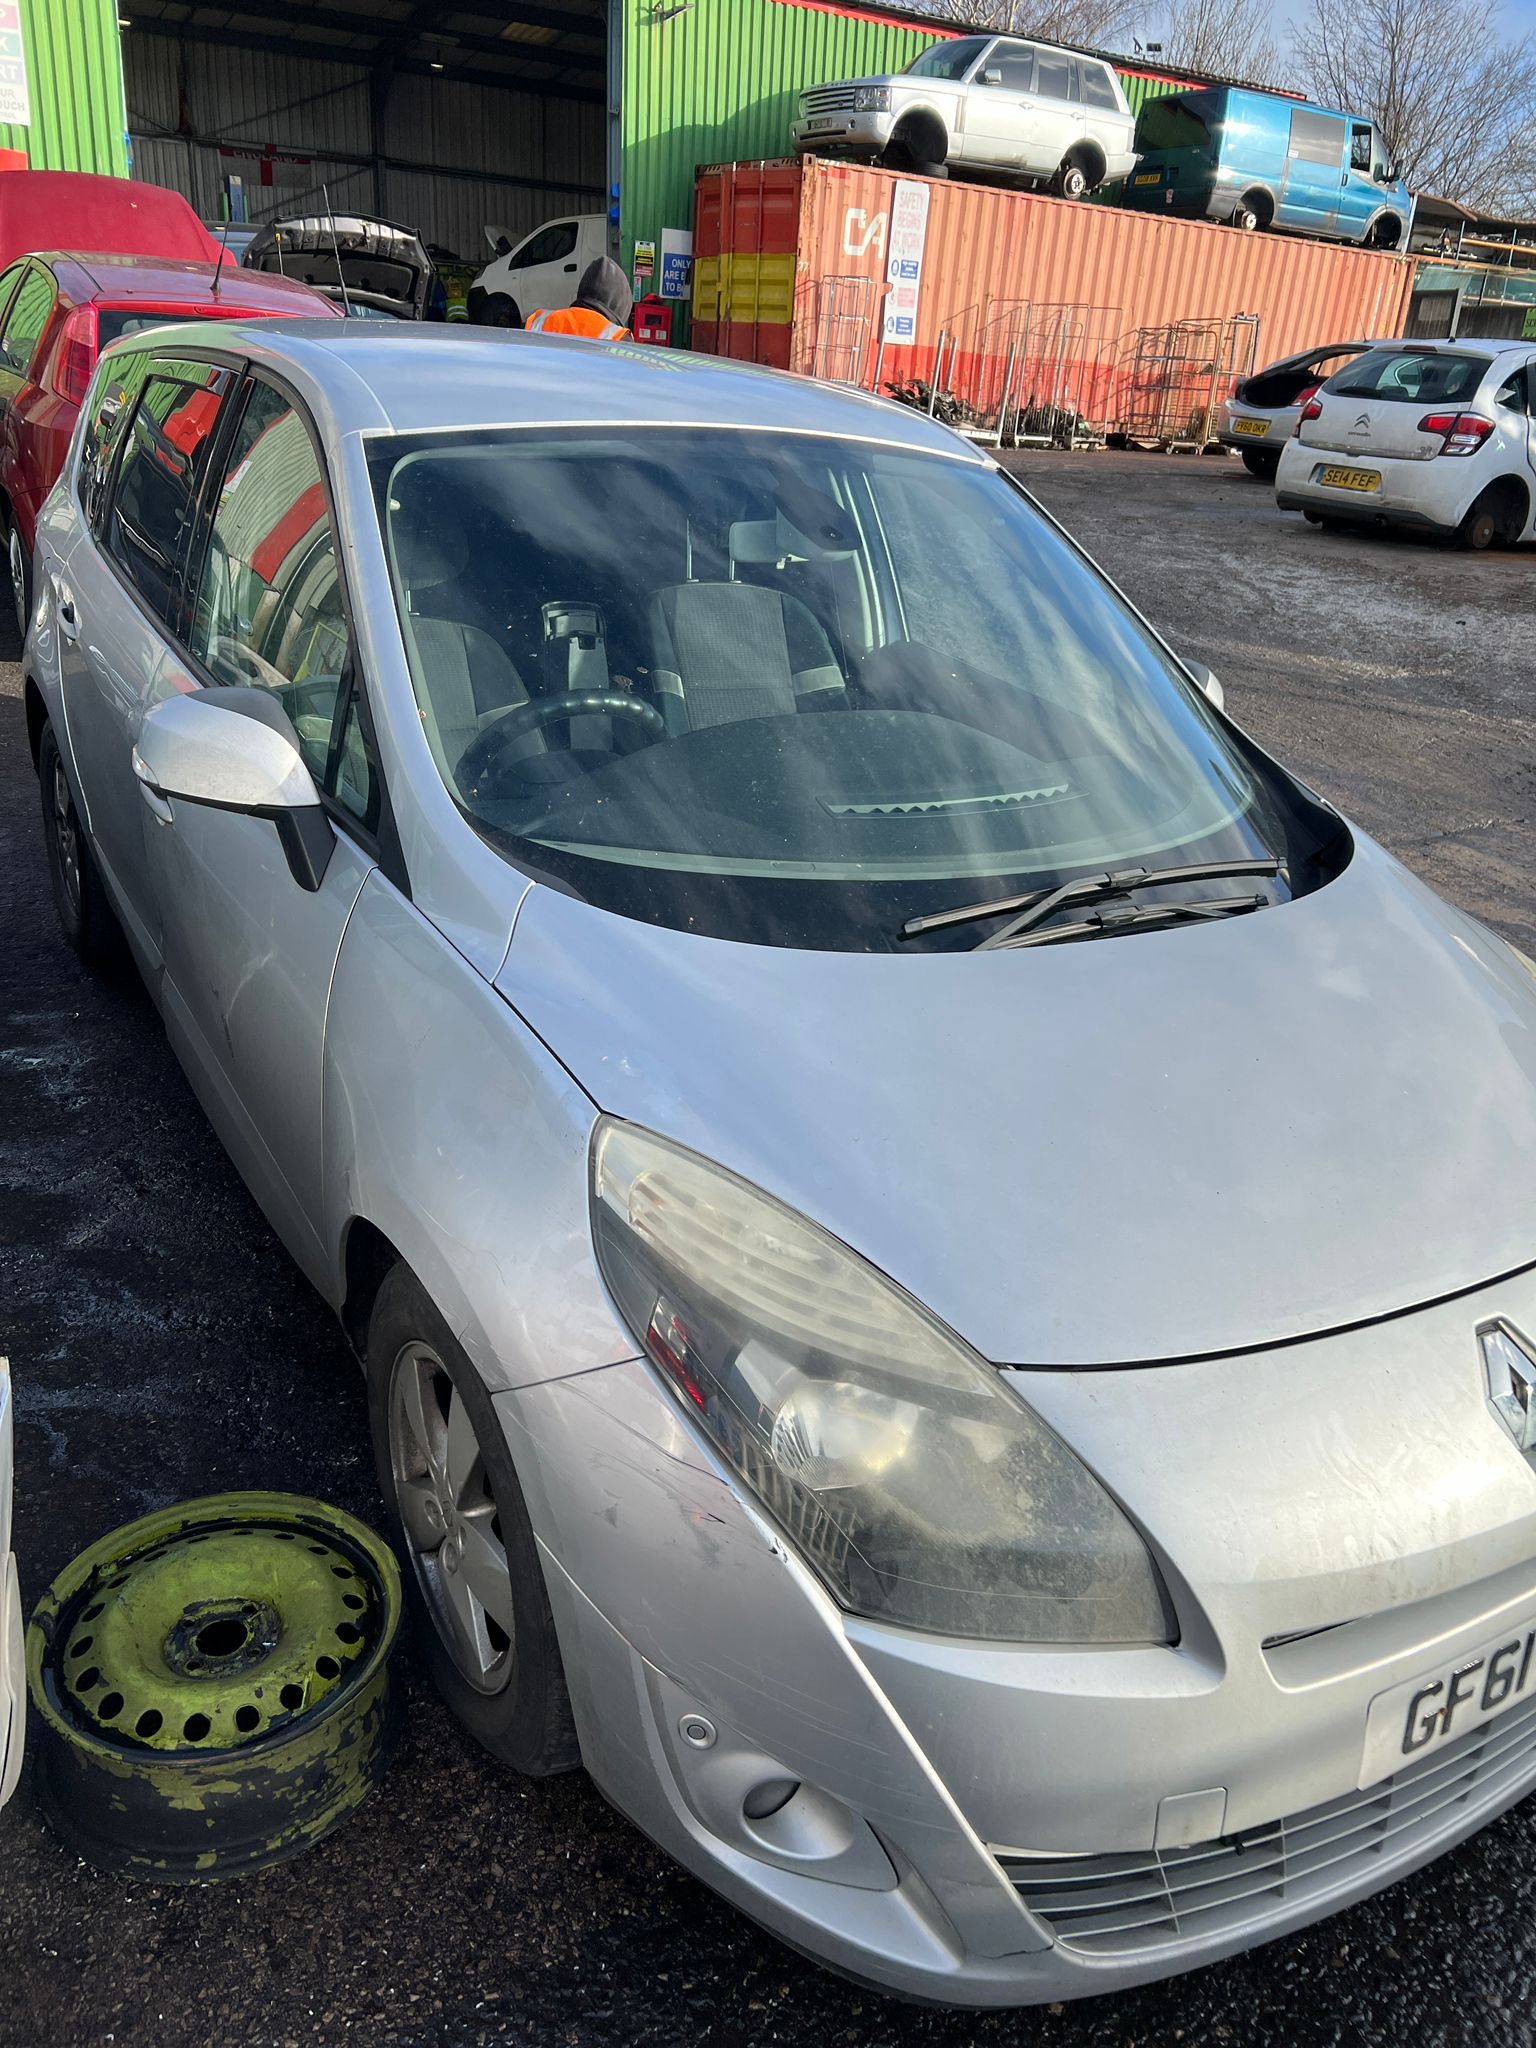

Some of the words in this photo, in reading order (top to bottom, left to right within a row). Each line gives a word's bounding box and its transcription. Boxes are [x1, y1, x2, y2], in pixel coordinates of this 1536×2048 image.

[671, 258, 692, 269] ONLY
[664, 270, 680, 280] ARE
[665, 282, 676, 292] TO
[1325, 470, 1350, 484] SE14
[1350, 473, 1376, 487] FEF
